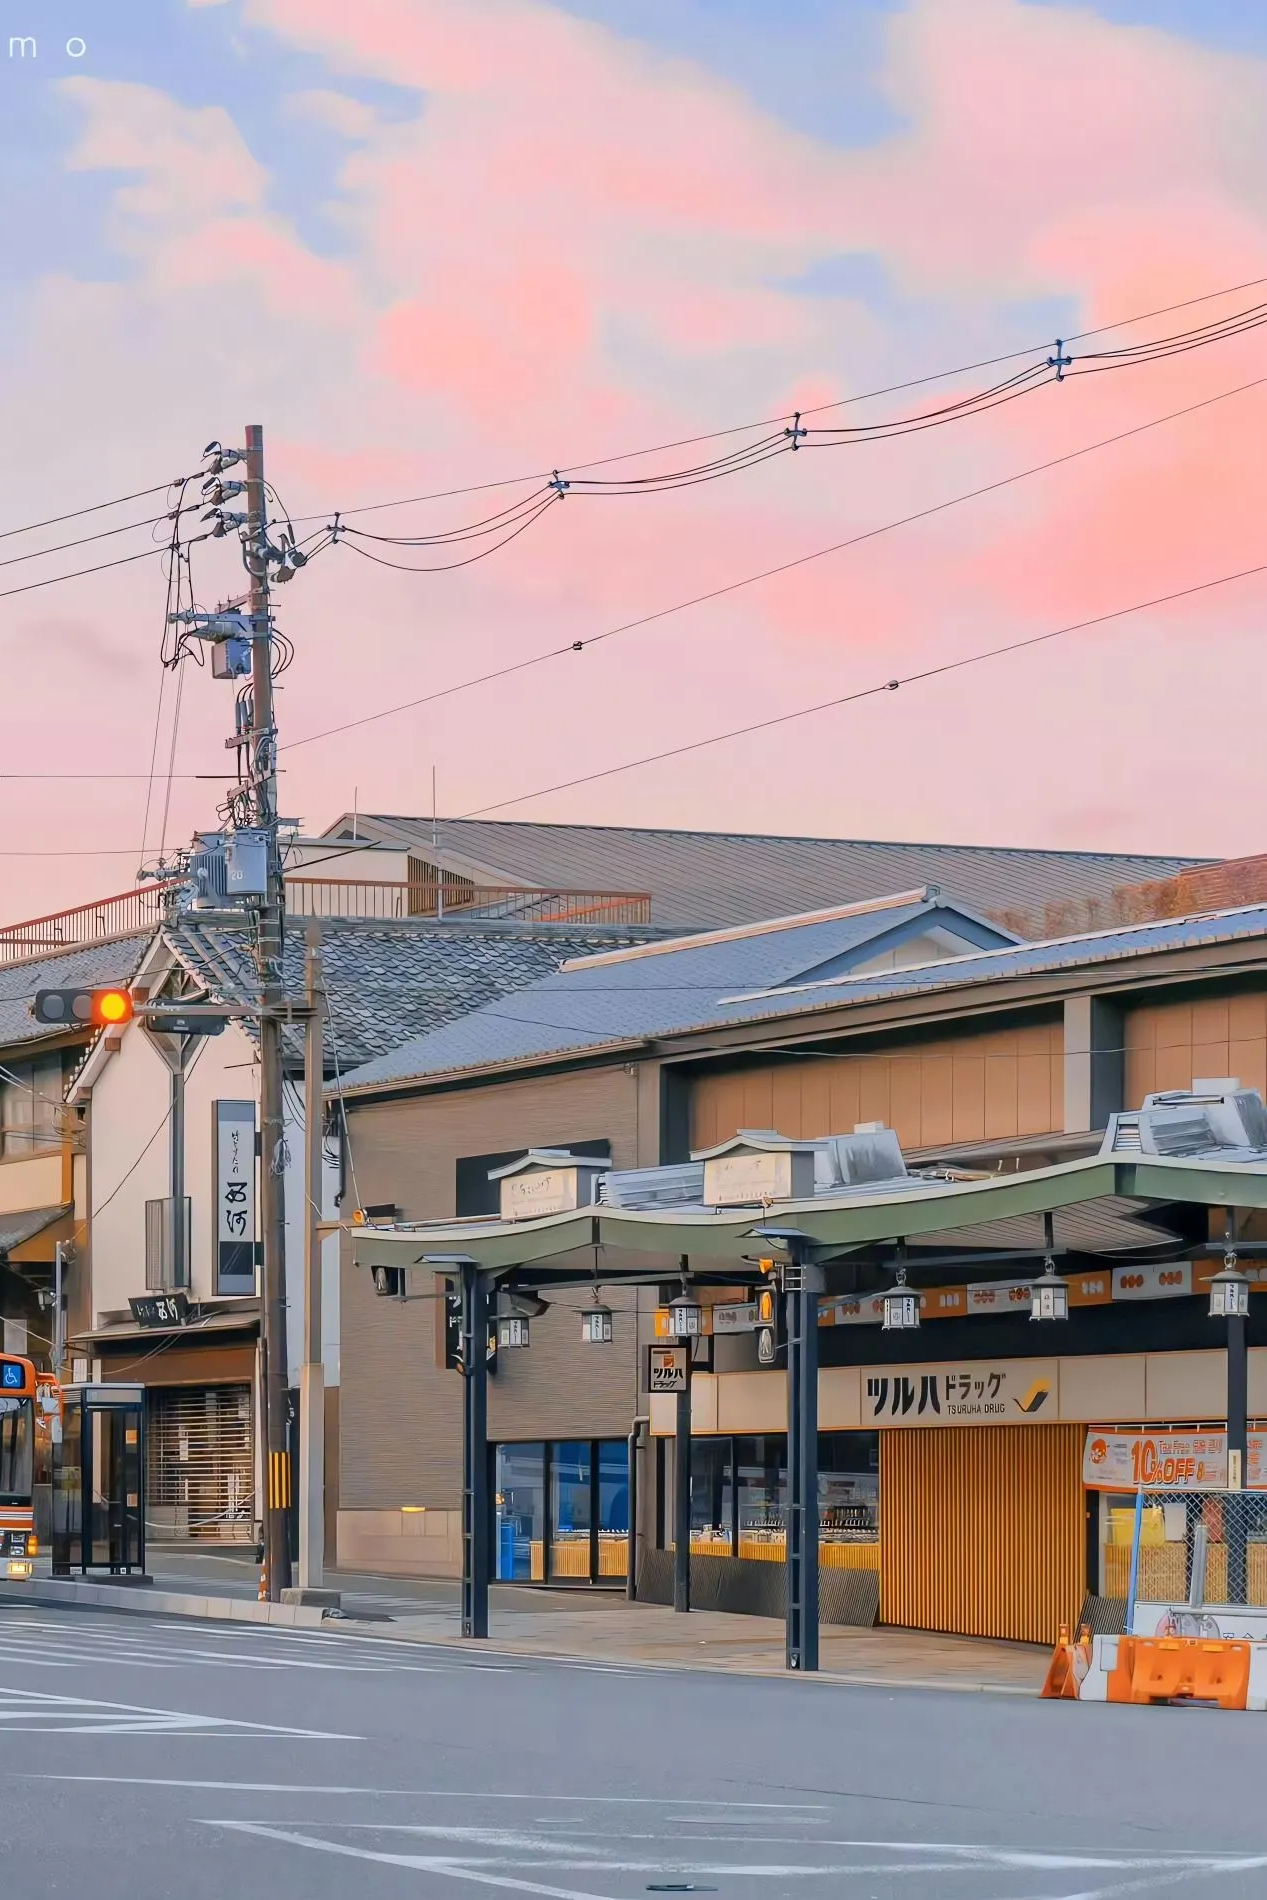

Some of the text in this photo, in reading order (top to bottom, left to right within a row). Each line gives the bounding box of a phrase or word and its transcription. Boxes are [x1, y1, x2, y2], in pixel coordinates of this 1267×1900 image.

[653, 1368, 684, 1379] ツルハ
[867, 1372, 1007, 1416] ツルハ ドラッグ
[947, 1403, 1005, 1415] TSURUHA DRUG
